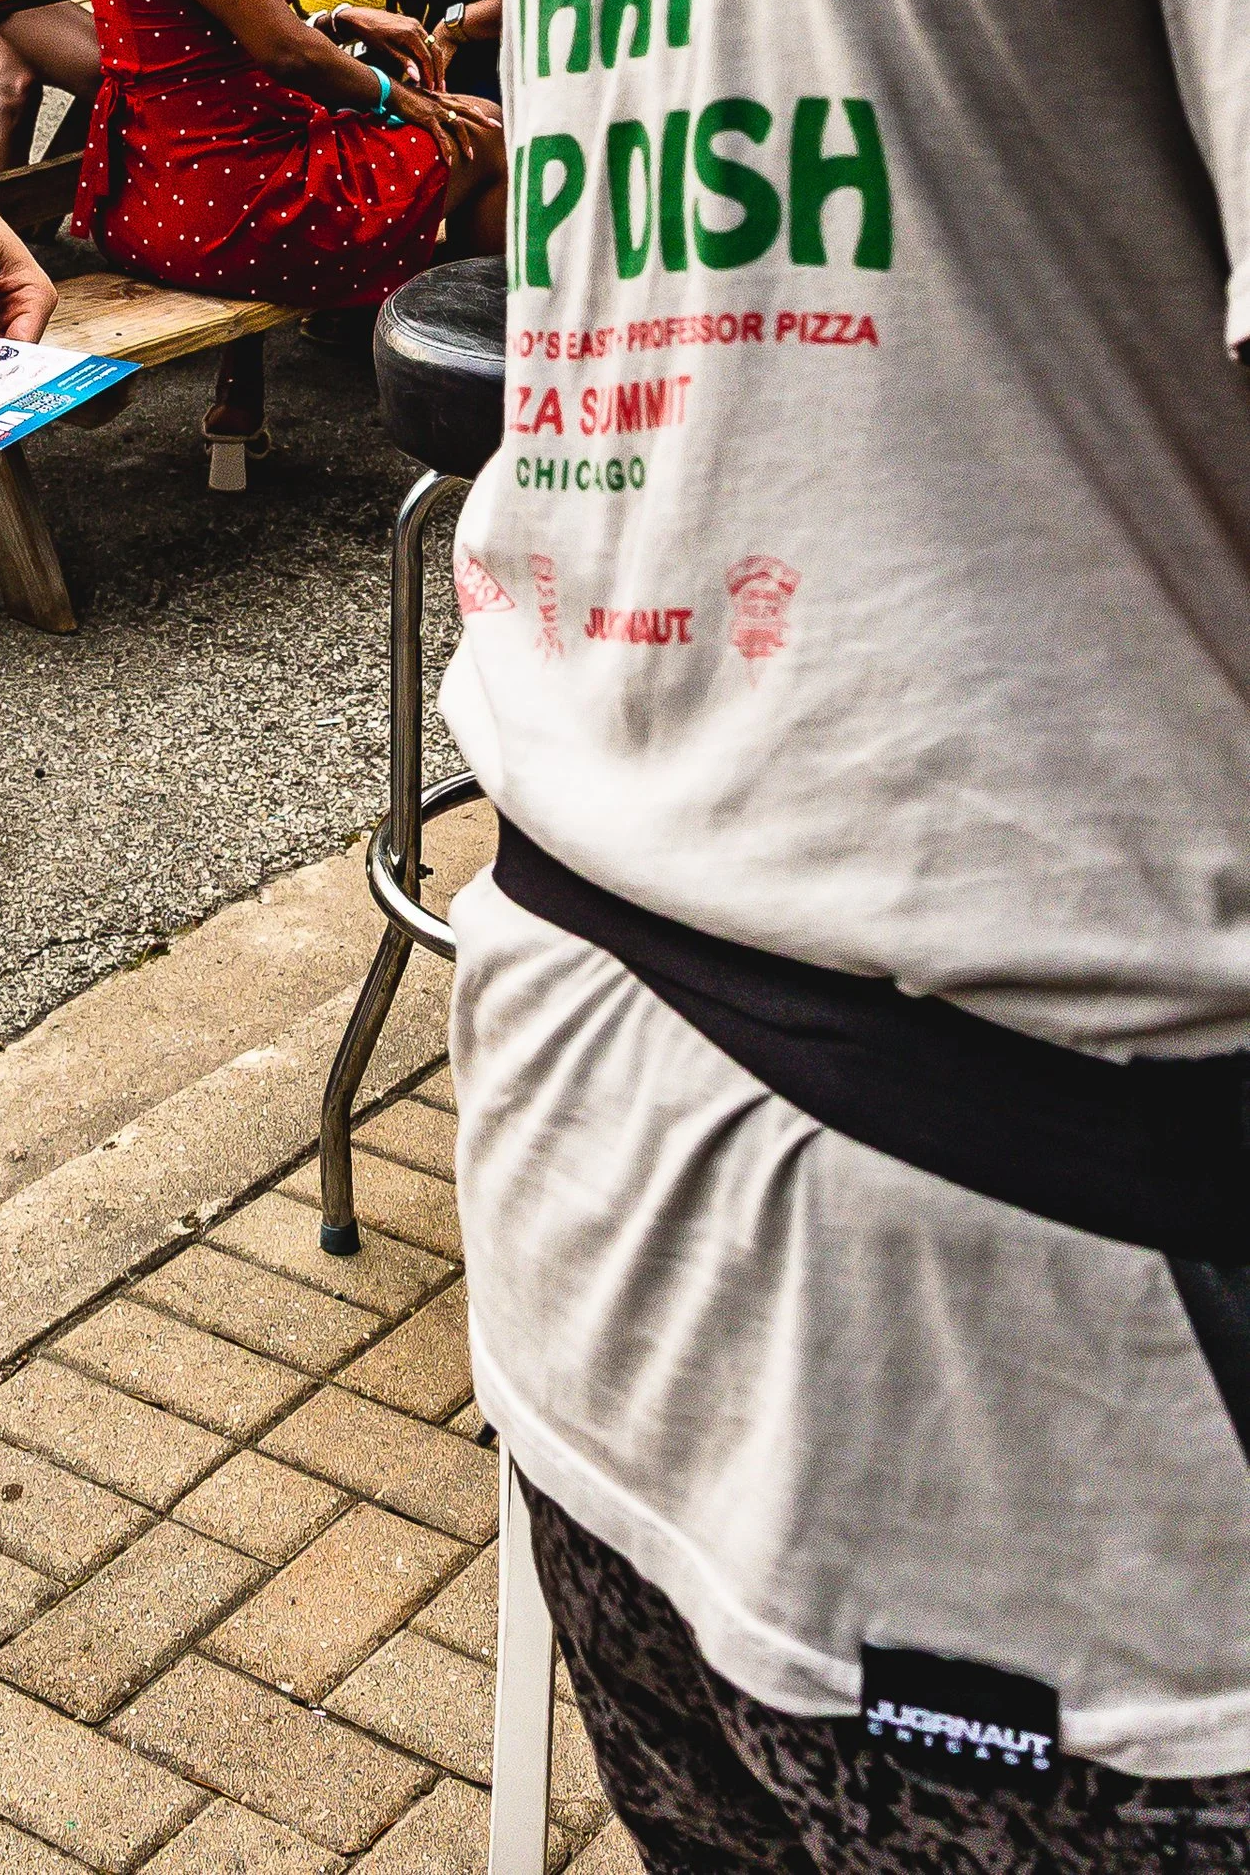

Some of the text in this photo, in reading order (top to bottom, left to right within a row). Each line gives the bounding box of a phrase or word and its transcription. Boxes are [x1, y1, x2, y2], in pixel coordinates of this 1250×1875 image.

[607, 98, 896, 279] DISH
[565, 327, 616, 361] EAST
[626, 311, 768, 352] PROFESSOR
[775, 310, 880, 347] PIZZA
